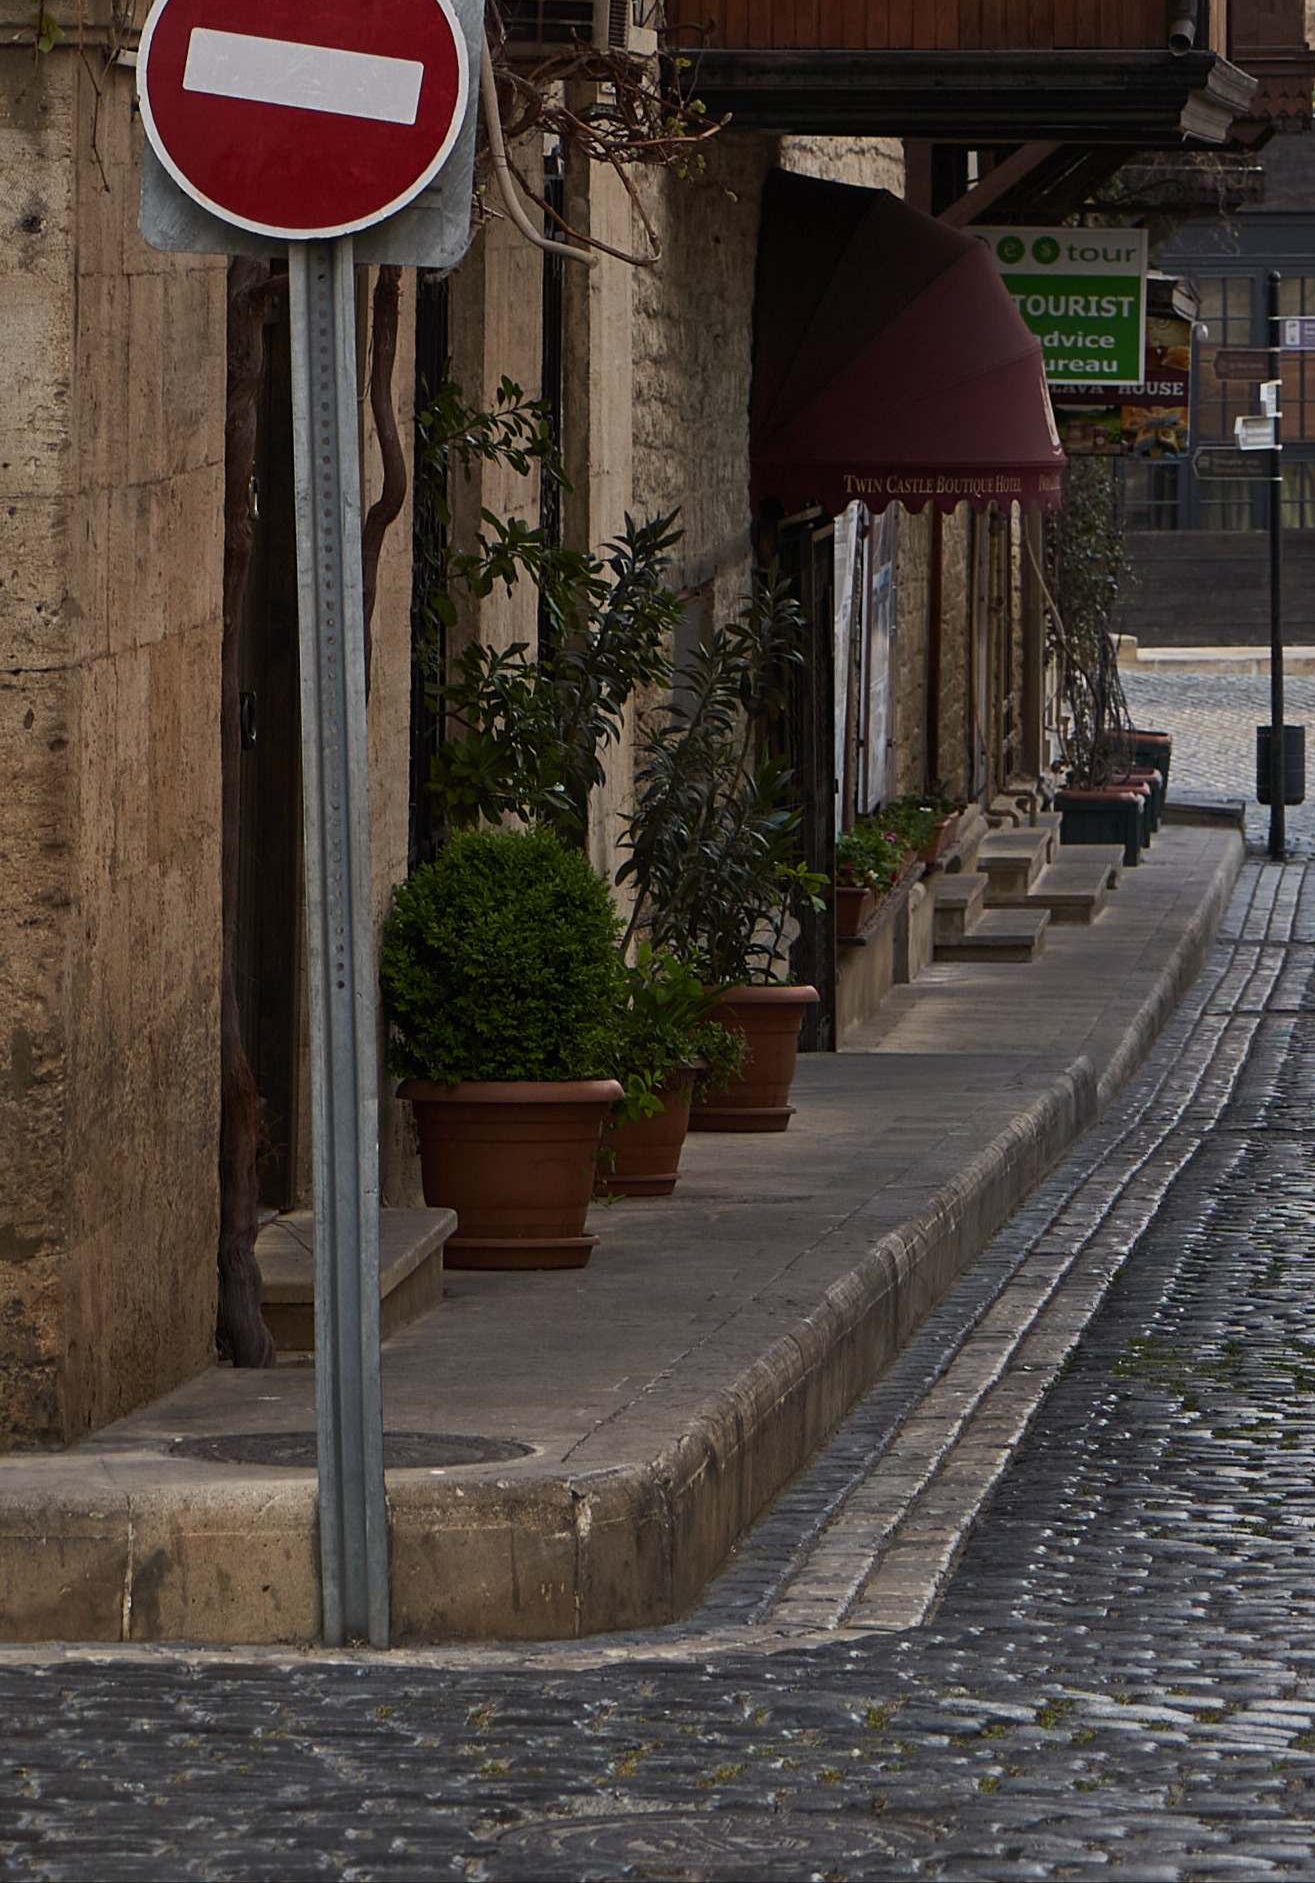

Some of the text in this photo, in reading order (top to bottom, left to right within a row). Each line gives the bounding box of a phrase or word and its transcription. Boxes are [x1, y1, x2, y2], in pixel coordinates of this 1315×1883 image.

[1066, 244, 1137, 263] tour
[1009, 294, 1134, 317] TOURIST
[1044, 358, 1118, 372] ureau
[1051, 381, 1184, 396] LAVA HOUSE
[844, 475, 883, 493] TWIN
[886, 474, 934, 493] CASTLE
[936, 475, 994, 497] BOUTIQUE
[996, 475, 1022, 493] HOTEL
